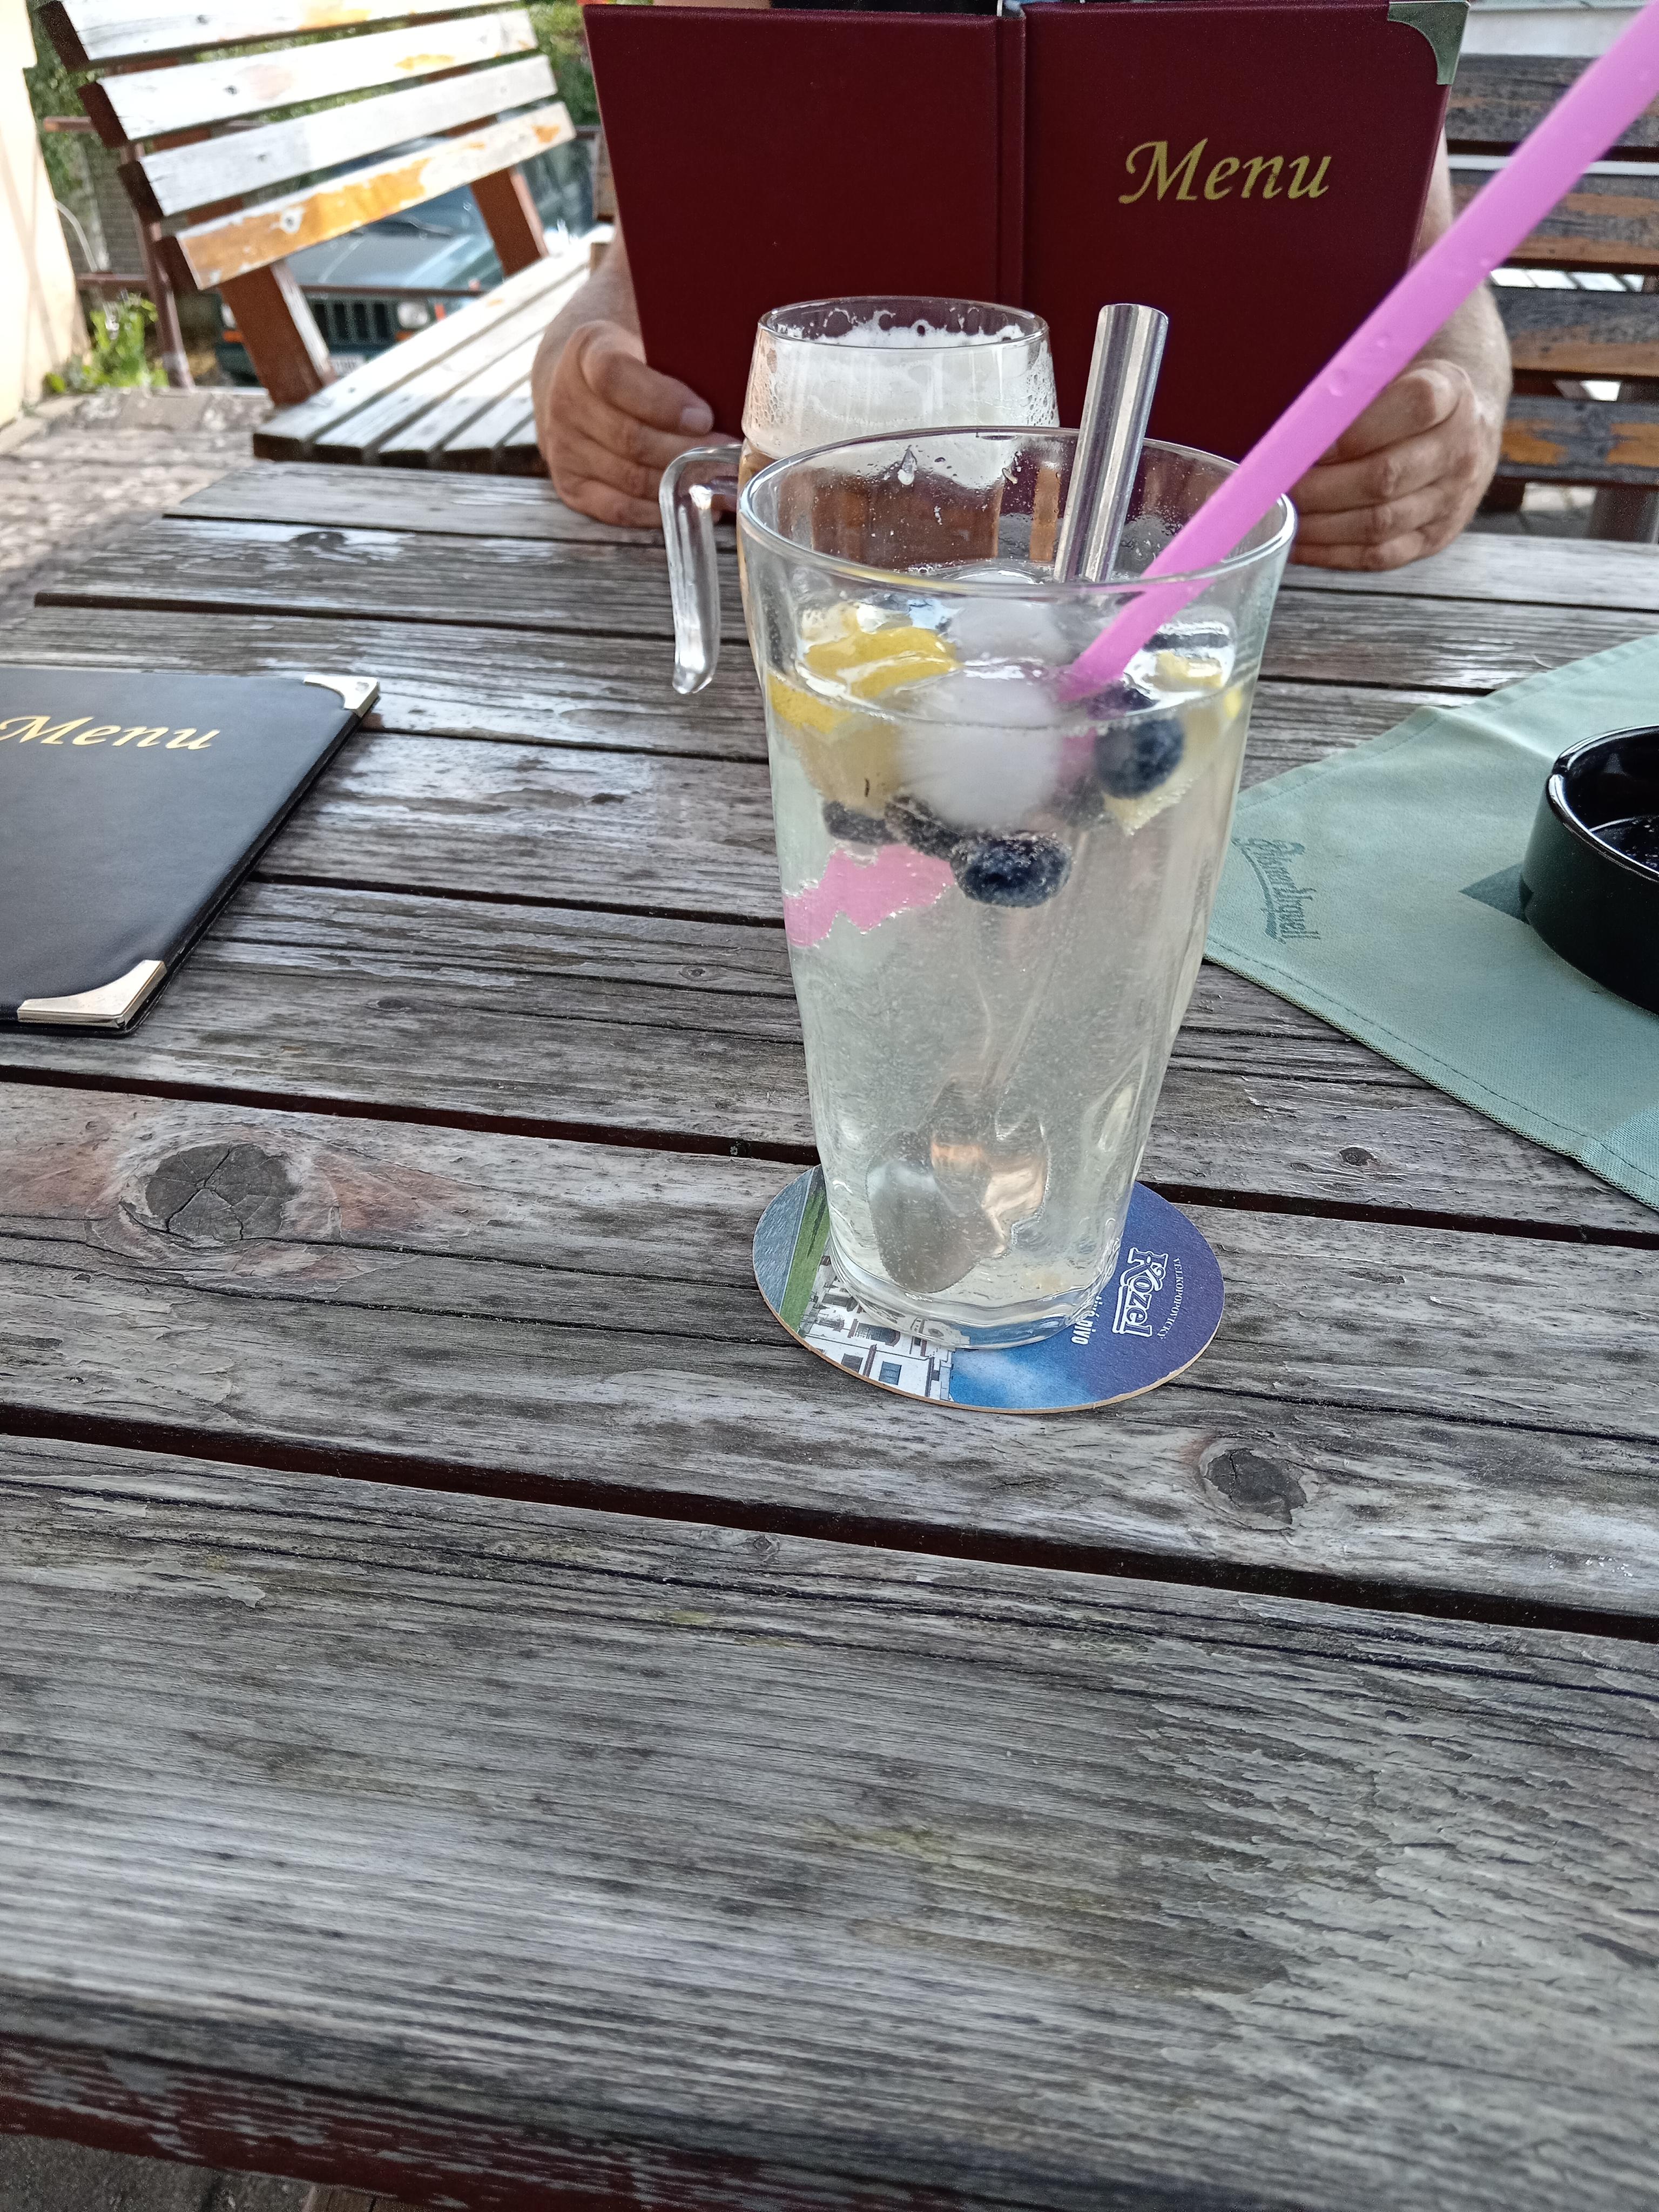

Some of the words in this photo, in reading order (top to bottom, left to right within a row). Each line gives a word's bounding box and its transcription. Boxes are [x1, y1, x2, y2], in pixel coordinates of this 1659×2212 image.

[1118, 137, 1332, 205] Menu
[0, 715, 221, 750] Menu
[1116, 1247, 1169, 1338] Kozel
[1071, 1320, 1096, 1345] pivo
